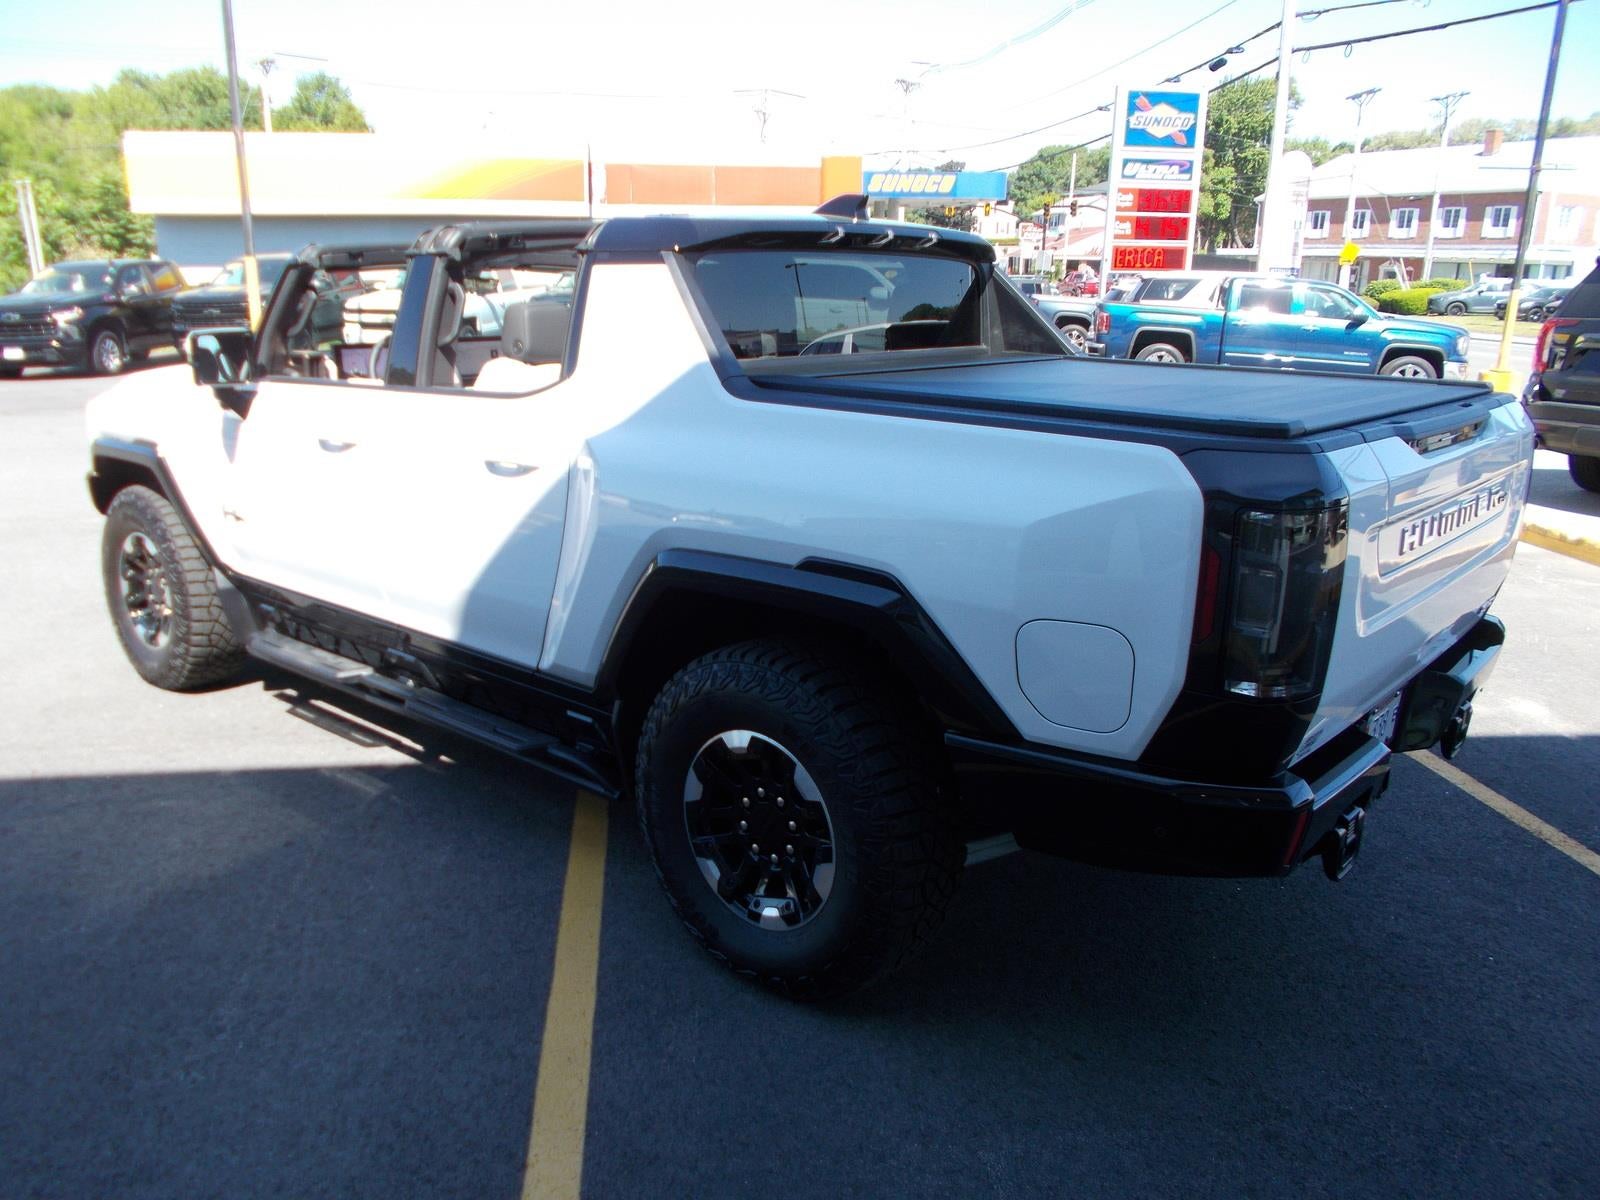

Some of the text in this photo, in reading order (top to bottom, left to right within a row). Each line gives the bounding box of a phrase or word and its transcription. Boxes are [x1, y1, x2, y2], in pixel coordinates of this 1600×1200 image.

[1133, 115, 1191, 128] SUNOCO
[867, 173, 957, 193] SUNOCO
[1115, 247, 1164, 267] ERICA
